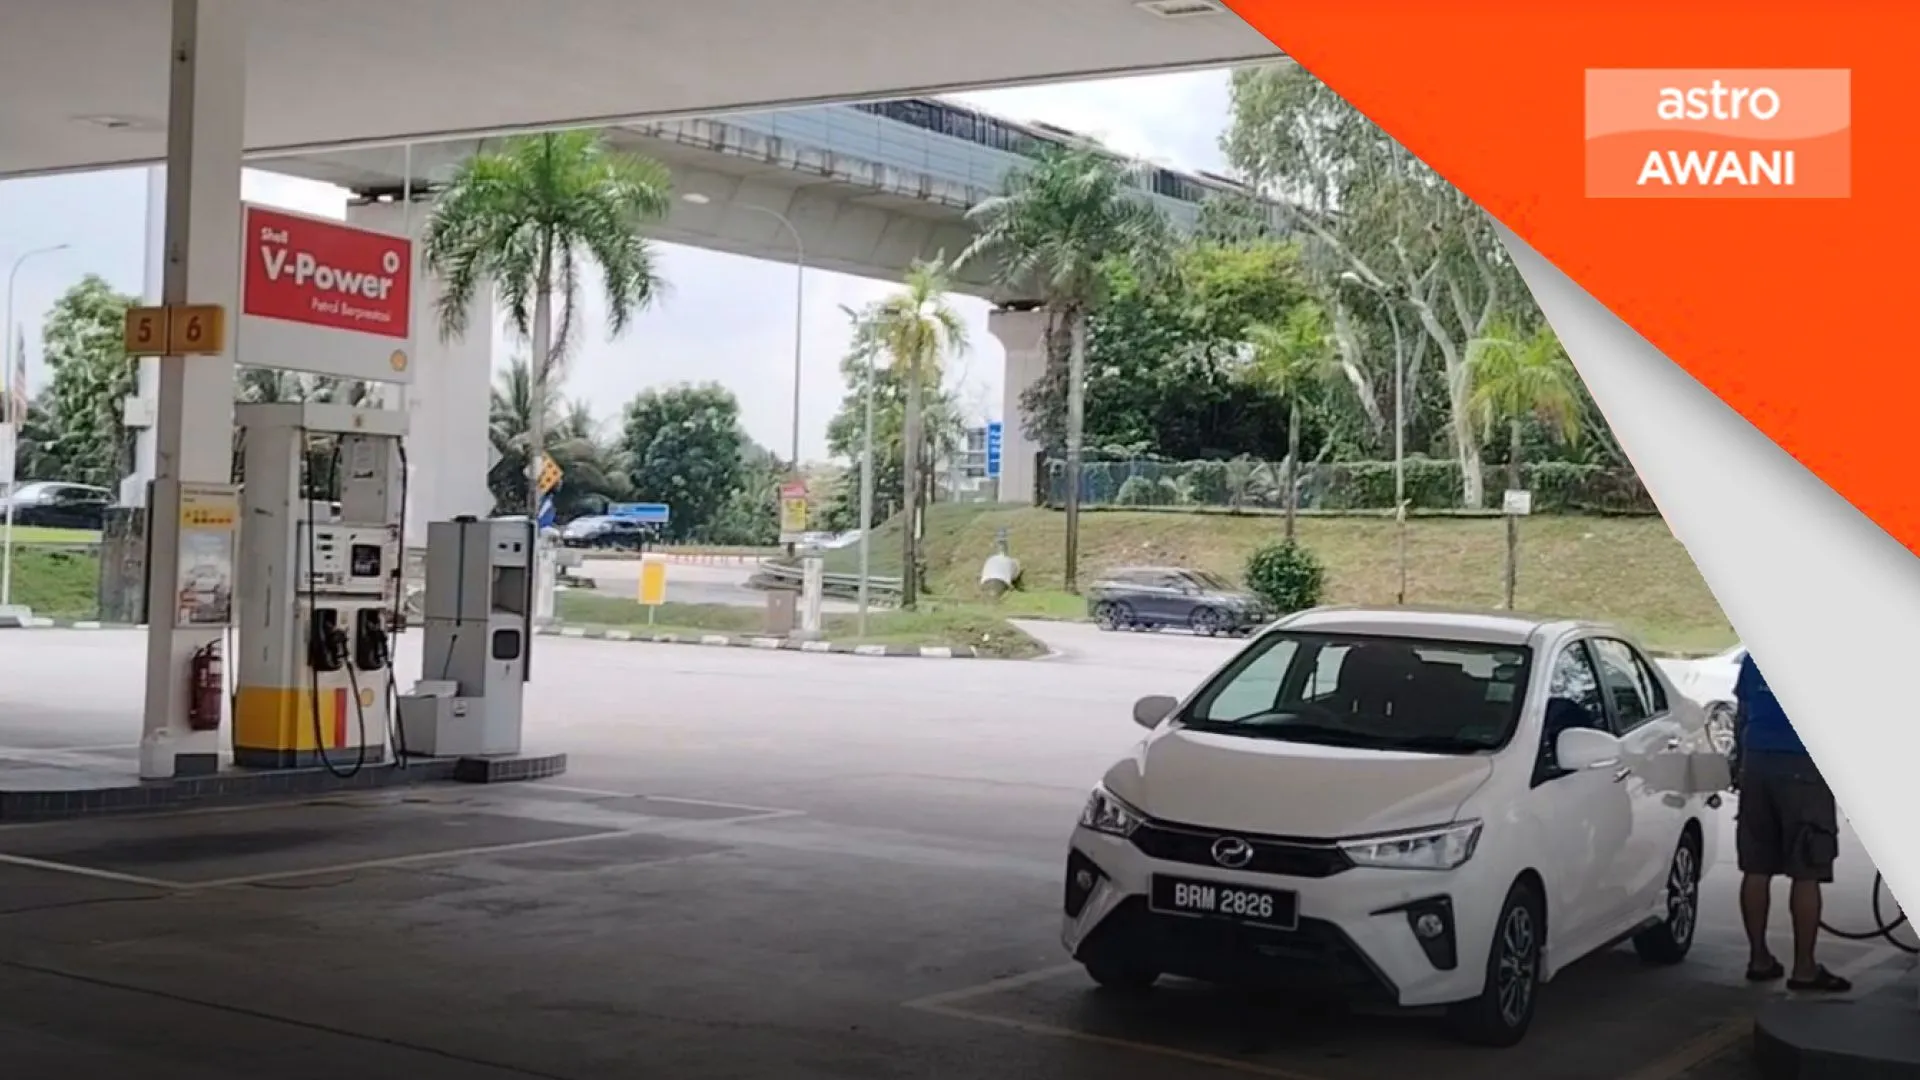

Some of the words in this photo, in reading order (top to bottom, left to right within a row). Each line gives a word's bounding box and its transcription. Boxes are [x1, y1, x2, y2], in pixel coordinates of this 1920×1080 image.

[261, 226, 289, 244] Shell
[260, 246, 393, 300] V-Power
[138, 317, 152, 343] 5
[186, 315, 202, 342] 6
[1175, 883, 1215, 910] BRM
[1220, 889, 1273, 918] 2826
